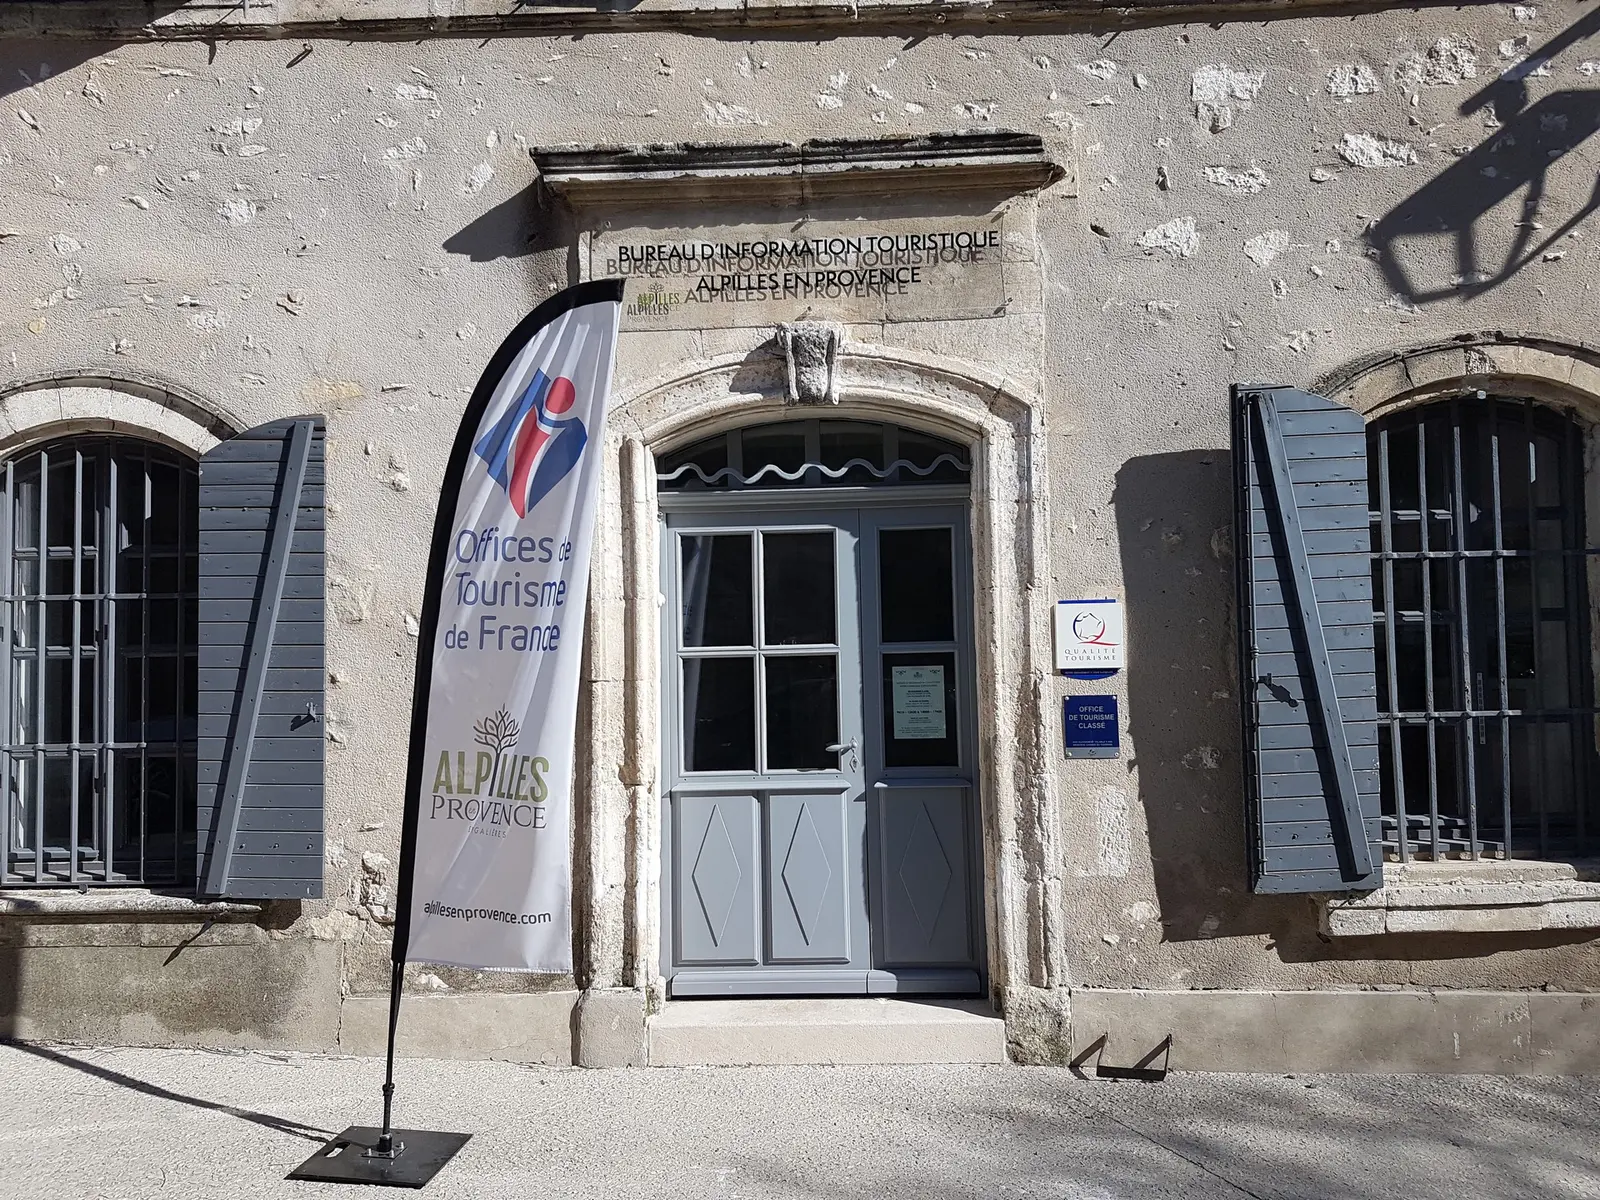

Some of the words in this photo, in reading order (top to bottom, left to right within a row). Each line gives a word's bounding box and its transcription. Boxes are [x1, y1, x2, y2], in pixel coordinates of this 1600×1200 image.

[619, 243, 695, 262] BUREAU
[701, 236, 862, 260] D'INFORMATION
[866, 230, 1000, 252] TOURISTIQUE
[696, 272, 779, 292] ALPILLES
[784, 271, 810, 289] EN
[815, 266, 922, 287] PROVENCE
[455, 526, 554, 564] Offices
[558, 536, 572, 563] de
[455, 572, 567, 608] Tourisme
[444, 624, 469, 650] de
[479, 615, 561, 652] France
[1078, 705, 1104, 713] OFFICE
[1080, 713, 1115, 721] TOURISME
[432, 750, 550, 803] ALPILLES
[429, 794, 548, 829] PROVENCE
